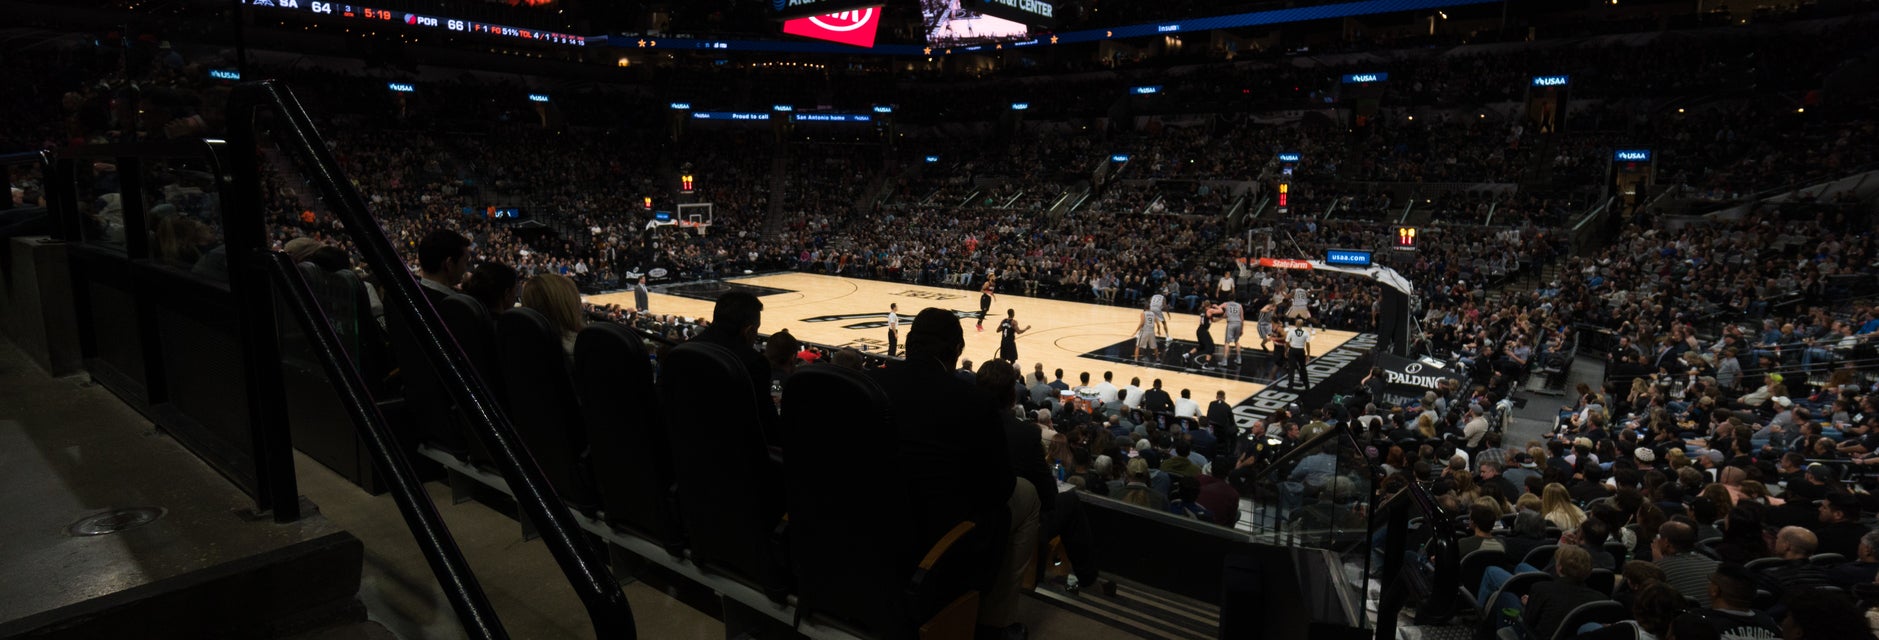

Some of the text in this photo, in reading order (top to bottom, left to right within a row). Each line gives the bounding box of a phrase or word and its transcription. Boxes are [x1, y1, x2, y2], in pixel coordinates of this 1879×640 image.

[1019, 0, 1053, 18] CENTER
[312, 2, 331, 14] 64
[364, 8, 391, 20] 5:19
[417, 15, 438, 26] POR
[448, 20, 463, 31] 66
[502, 28, 519, 37] 51%
[1361, 74, 1377, 82] USAA
[1544, 77, 1566, 85] USAA
[1331, 254, 1365, 263] usaa.com
